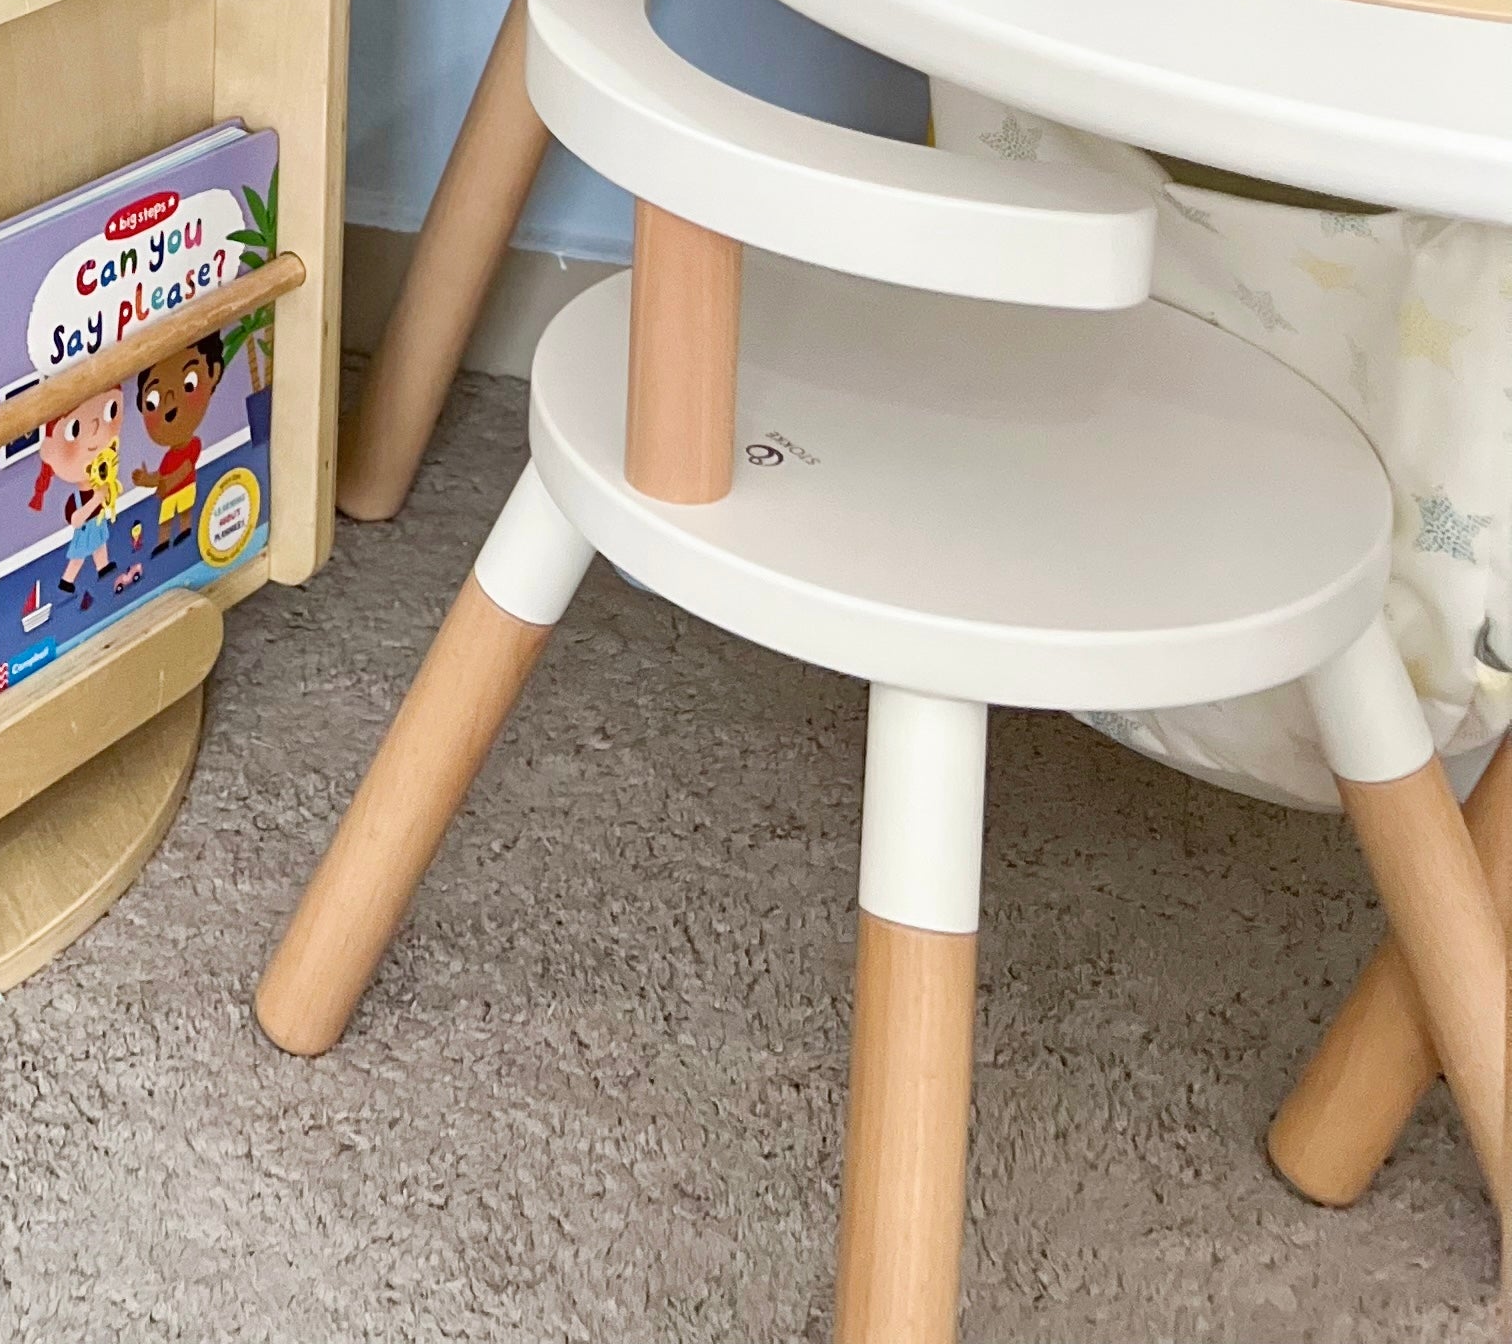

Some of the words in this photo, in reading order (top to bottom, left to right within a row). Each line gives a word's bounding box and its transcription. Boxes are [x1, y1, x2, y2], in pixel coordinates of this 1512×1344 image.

[118, 212, 137, 231] big
[137, 201, 167, 223] steps
[148, 217, 202, 273] you
[116, 248, 226, 342] please?
[11, 645, 49, 676] Campbell
